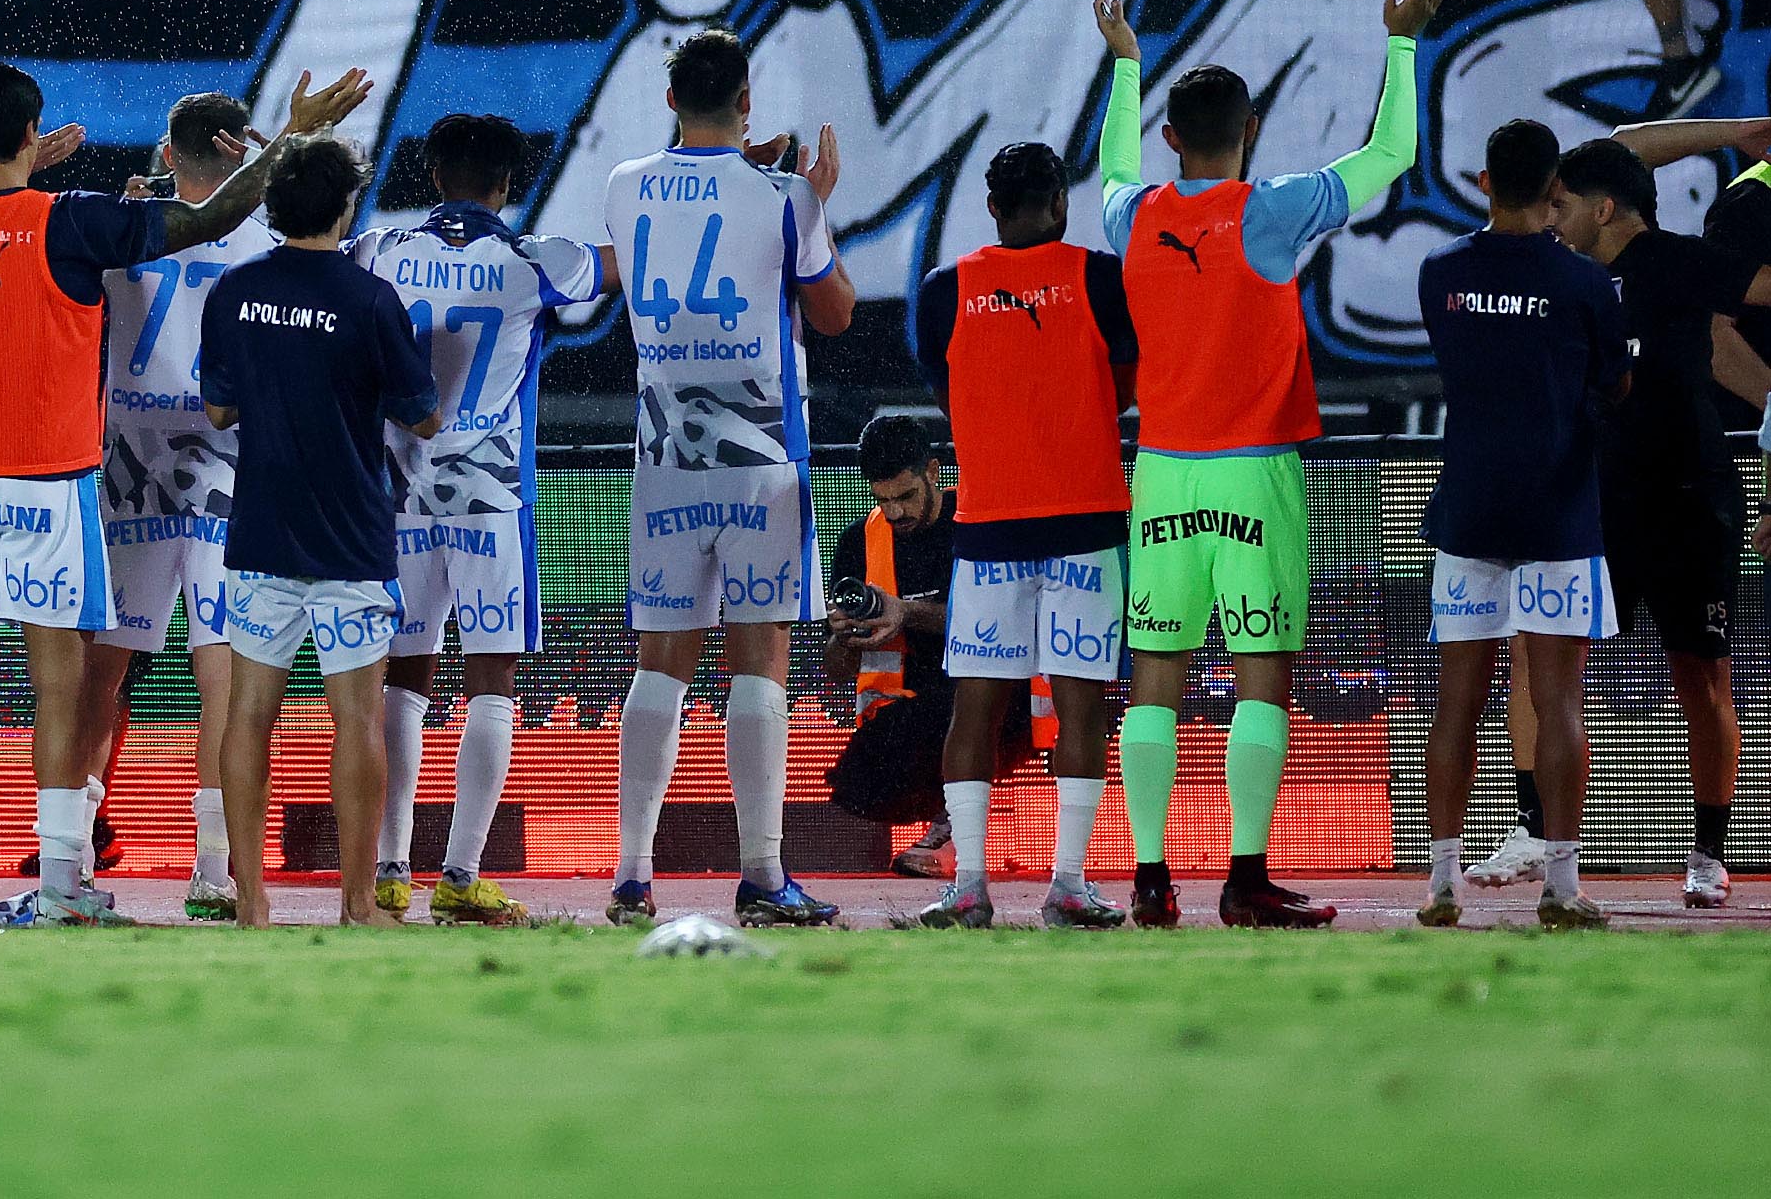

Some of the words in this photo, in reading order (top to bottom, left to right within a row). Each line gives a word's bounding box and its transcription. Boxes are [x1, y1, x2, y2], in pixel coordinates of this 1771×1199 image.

[639, 174, 720, 201] KVIDA
[396, 258, 504, 292] CLINTON
[631, 213, 749, 334] 44
[1050, 285, 1075, 306] FC
[1446, 292, 1522, 316] APOLLON
[1526, 297, 1550, 319] FC
[238, 301, 313, 328] APOLLON
[314, 310, 338, 333] FC
[693, 337, 762, 361] island
[4, 557, 77, 610] bbf:
[723, 560, 801, 607] bbf:
[1518, 567, 1590, 619] bbf:
[456, 586, 520, 635] bbf
[949, 635, 1029, 661] fpmarkets
[1050, 611, 1119, 663] bbf
